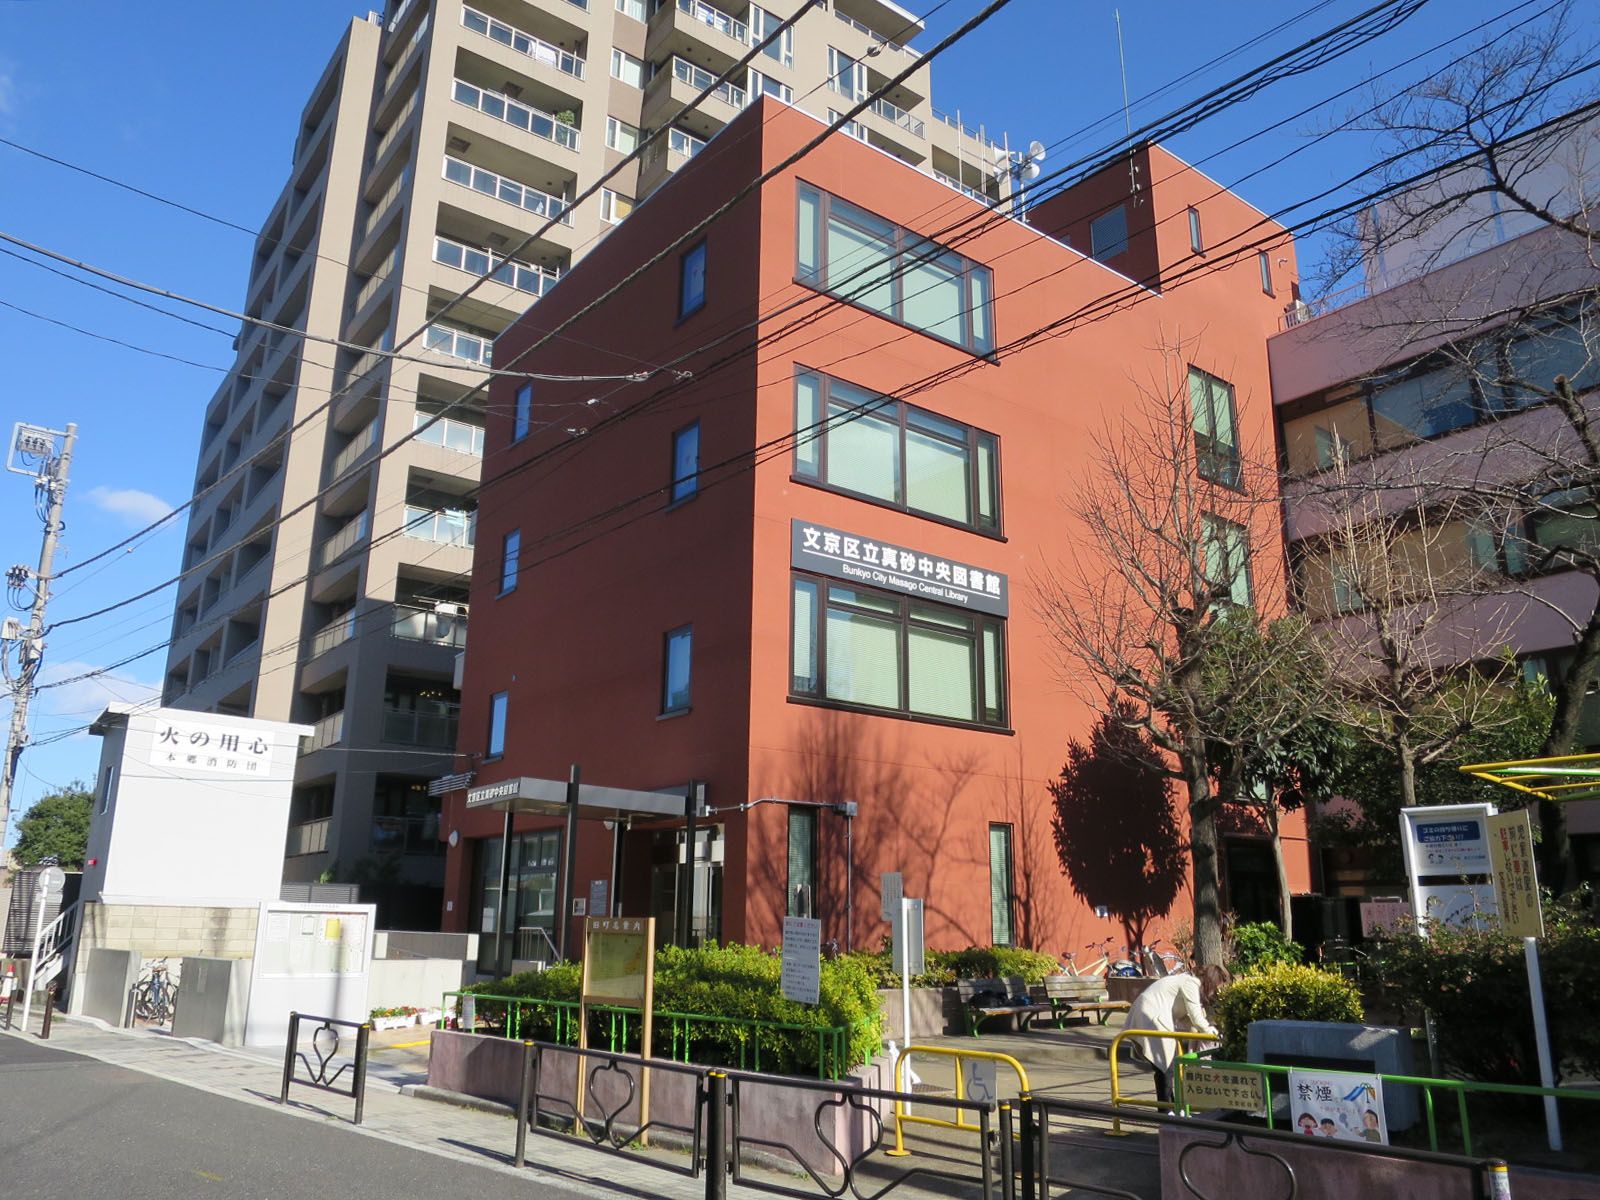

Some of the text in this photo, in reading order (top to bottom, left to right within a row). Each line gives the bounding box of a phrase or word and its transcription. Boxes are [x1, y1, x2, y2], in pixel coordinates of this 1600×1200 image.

[802, 527, 1001, 596] 文京区立真砂中央図書館
[842, 563, 969, 604] Bunkyo City Masago Central Library
[159, 726, 268, 755] 火の用心
[166, 752, 257, 771] 本郷消防団
[1296, 1083, 1333, 1102] 禁煙
